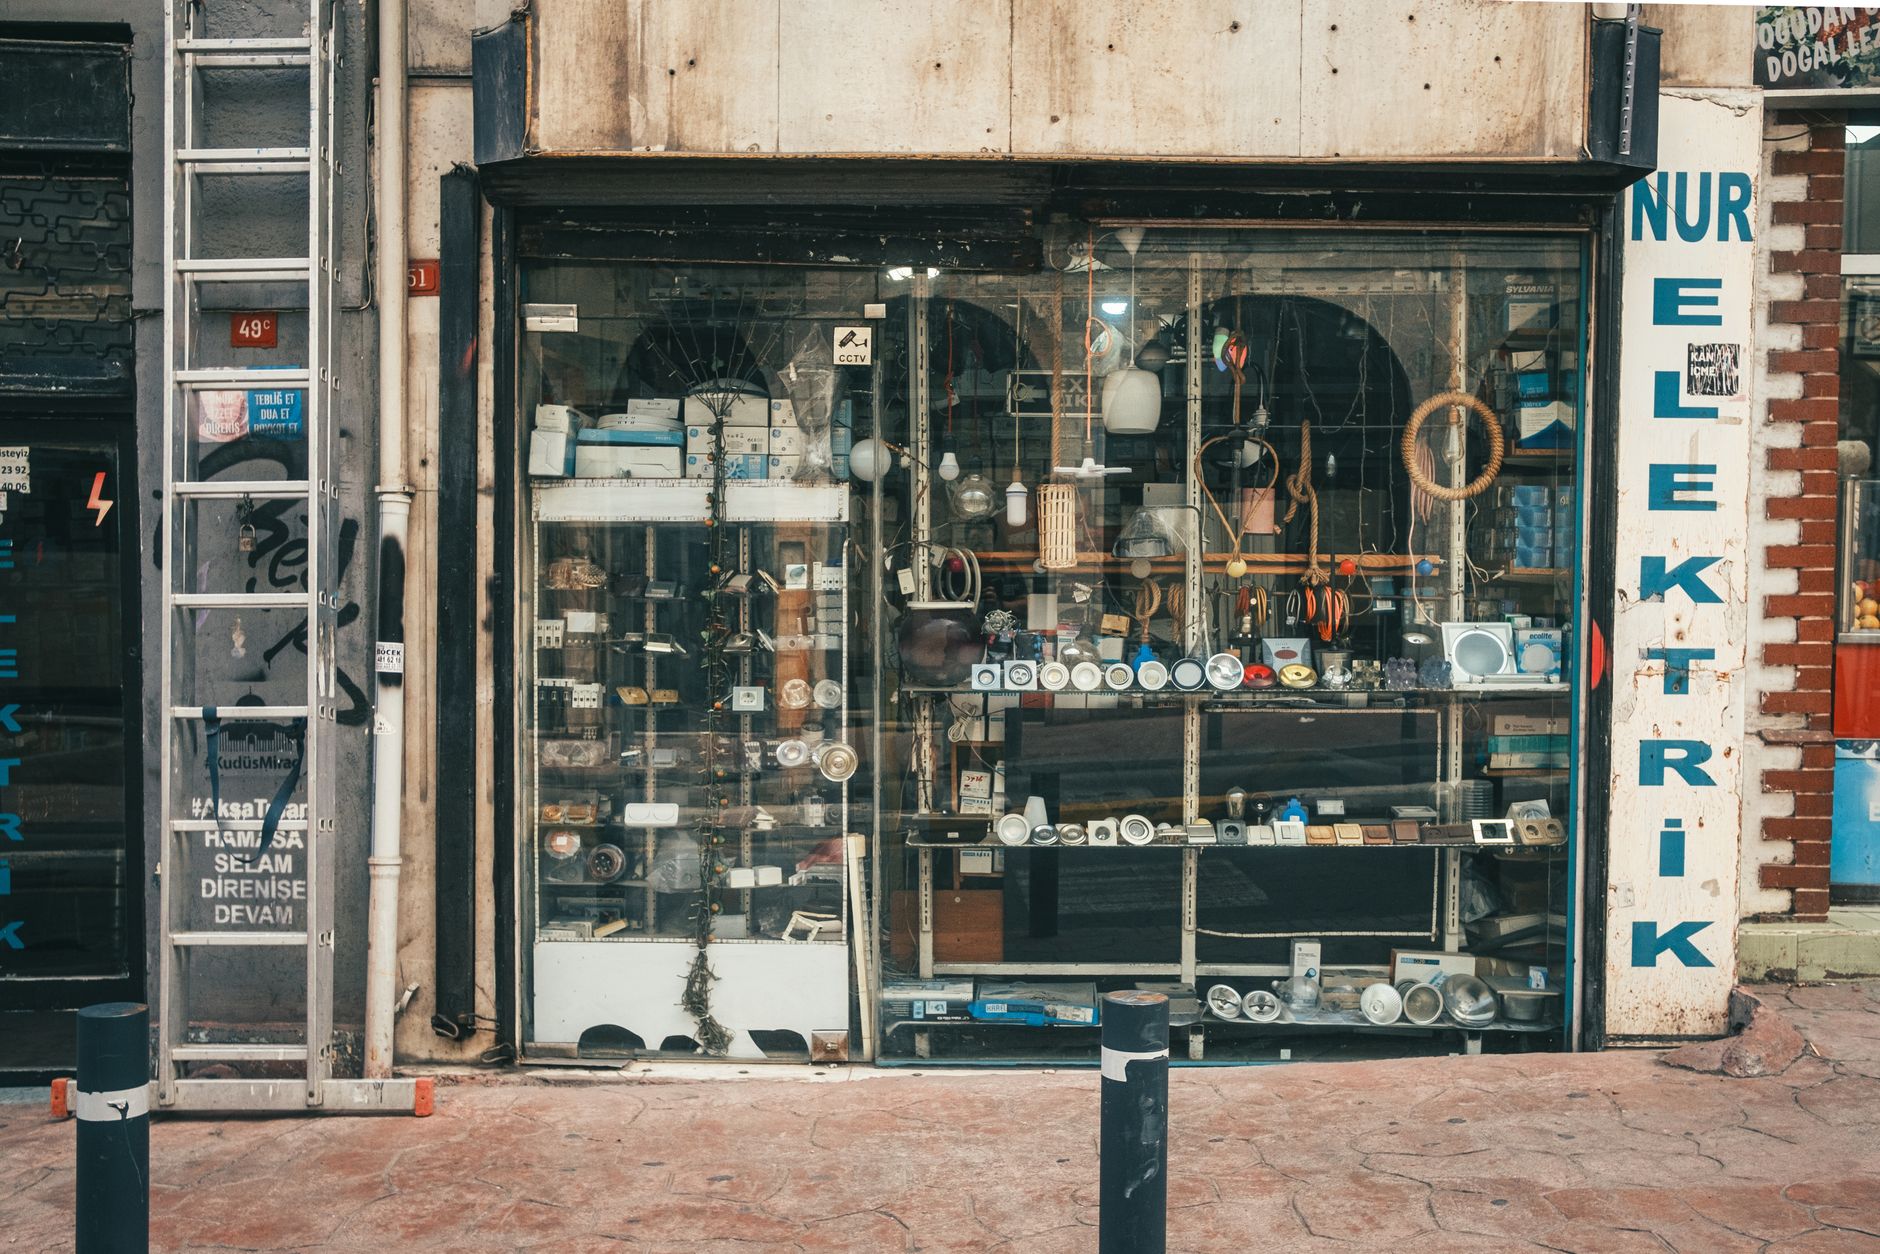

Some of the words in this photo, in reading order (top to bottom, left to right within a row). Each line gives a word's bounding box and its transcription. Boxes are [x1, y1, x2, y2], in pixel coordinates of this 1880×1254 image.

[1767, 37, 1841, 82] DOĞAL
[1631, 171, 1754, 243] NUR
[1505, 285, 1554, 294] SYLVANIA
[839, 355, 866, 363] CCTV
[1691, 352, 1714, 362] KAN
[254, 391, 283, 405] TEBLİĞ
[285, 393, 295, 405] ET
[260, 408, 279, 420] DUA
[280, 408, 290, 420] ET
[1, 466, 13, 475] 23
[15, 466, 27, 475] 92
[214, 853, 293, 873] SELAM
[214, 903, 293, 924] DEVAM
